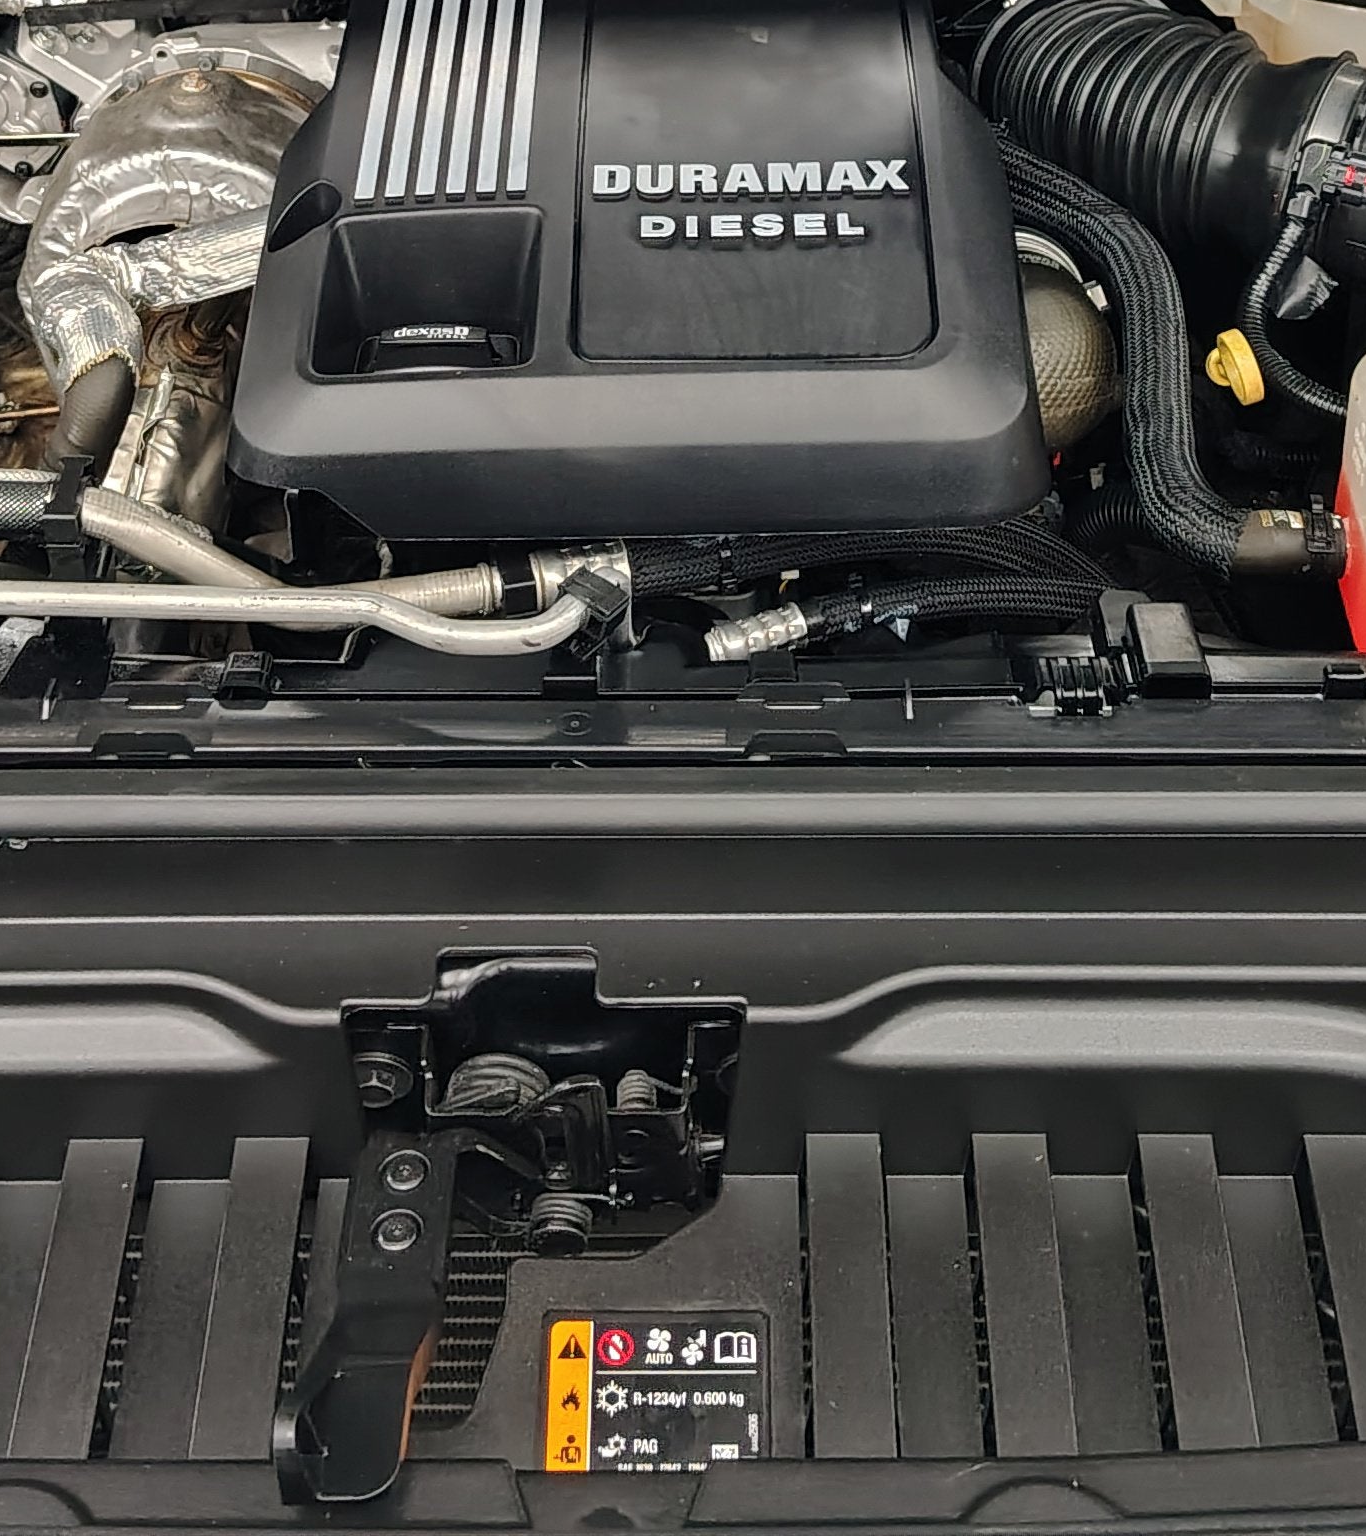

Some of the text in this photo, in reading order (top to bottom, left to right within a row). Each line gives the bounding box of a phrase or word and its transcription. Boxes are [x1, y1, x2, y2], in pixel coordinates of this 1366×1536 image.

[592, 160, 910, 196] DURAMAX
[639, 213, 866, 239] DIESEL
[644, 1352, 674, 1365] AUTO
[633, 1391, 745, 1408] R-1234yf 0.600 kg
[633, 1438, 659, 1455] PAG
